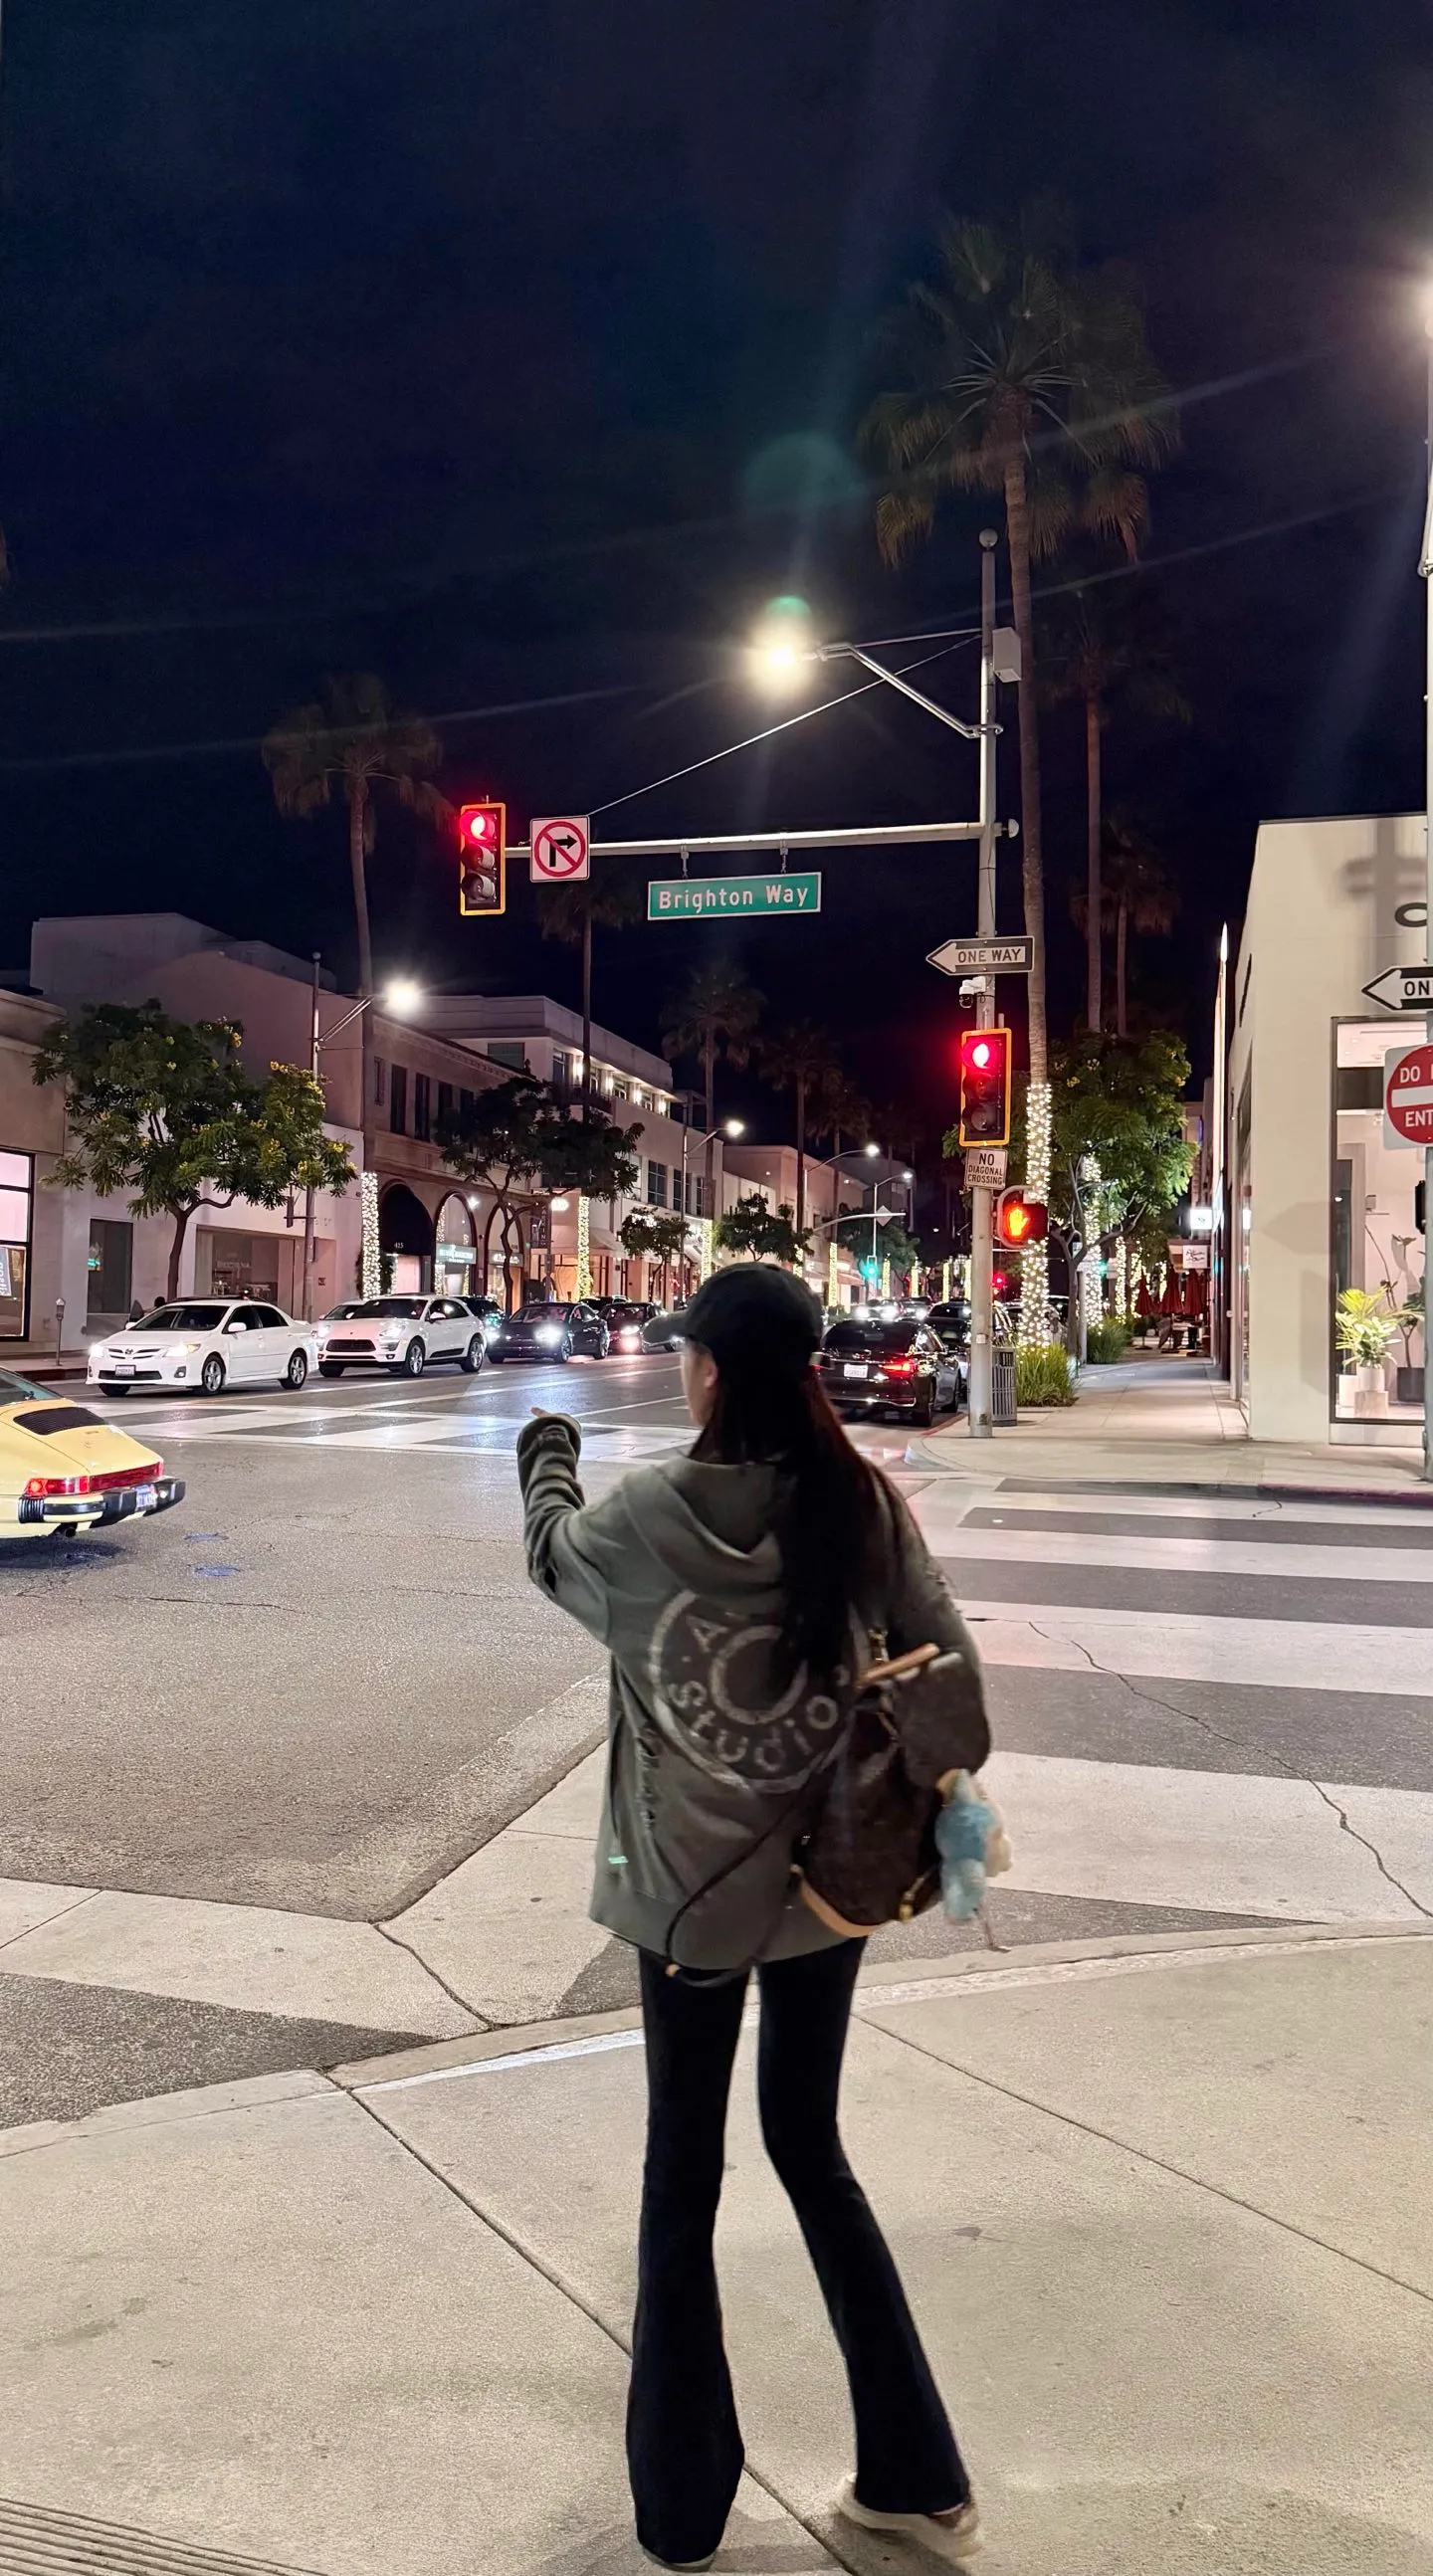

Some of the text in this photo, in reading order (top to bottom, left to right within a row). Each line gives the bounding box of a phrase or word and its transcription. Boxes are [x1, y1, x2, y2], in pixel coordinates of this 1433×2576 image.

[659, 885, 808, 913] Brighton Way
[957, 948, 1021, 963] ONE WAY
[1404, 980, 1430, 996] ON
[1399, 1065, 1421, 1084] DO
[1405, 1109, 1433, 1127] ENT
[979, 1153, 995, 1166] NO
[968, 1164, 1003, 1176] DIAGONAL
[967, 1174, 1003, 1186] CROSSING
